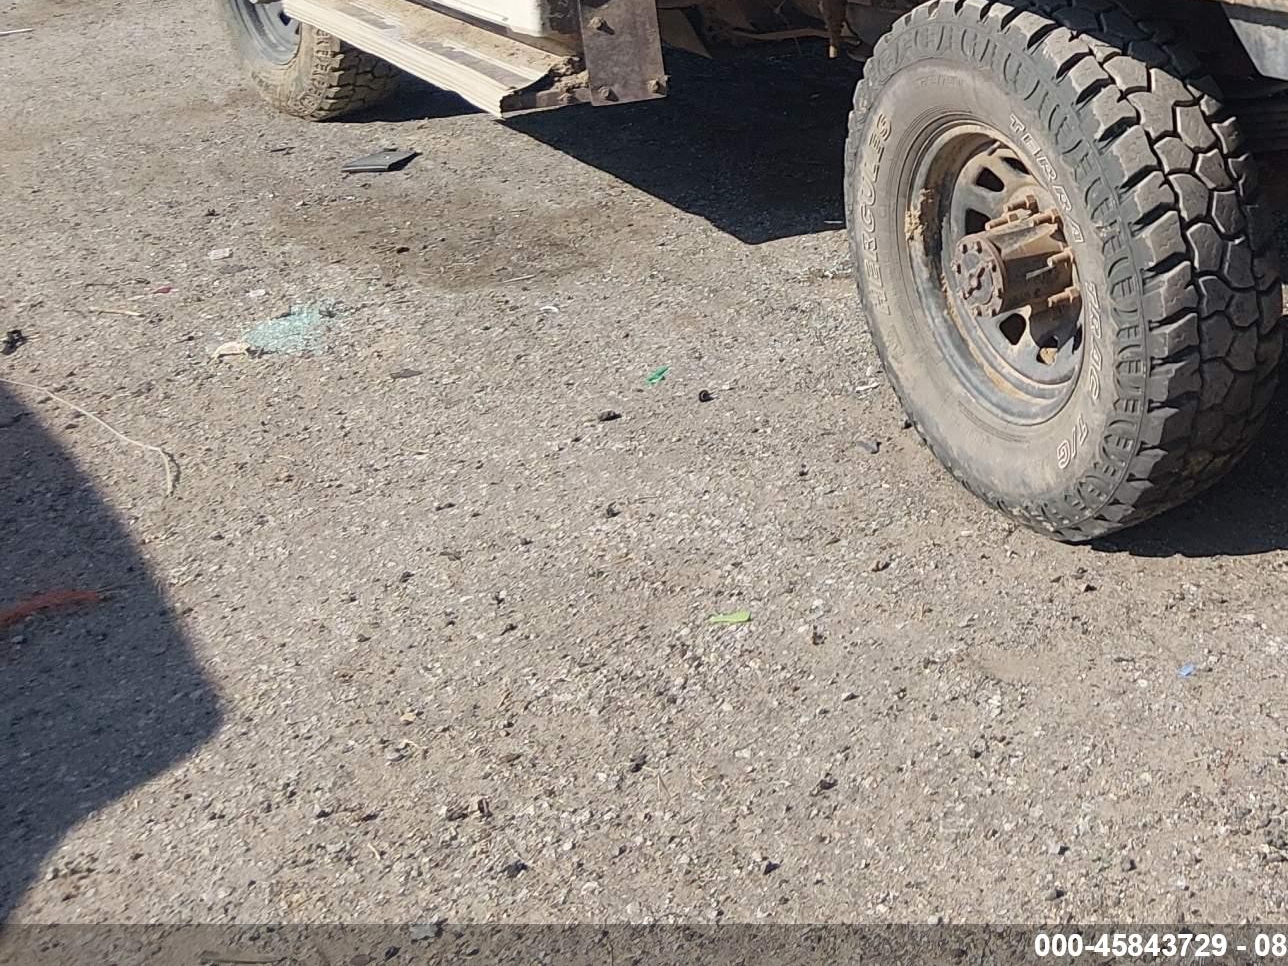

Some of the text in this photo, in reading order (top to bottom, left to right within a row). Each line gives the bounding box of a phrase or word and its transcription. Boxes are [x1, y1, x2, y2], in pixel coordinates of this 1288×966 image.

[858, 113, 892, 316] HERCULES
[1009, 113, 1085, 243] TERRA
[1084, 280, 1103, 401] TRAC
